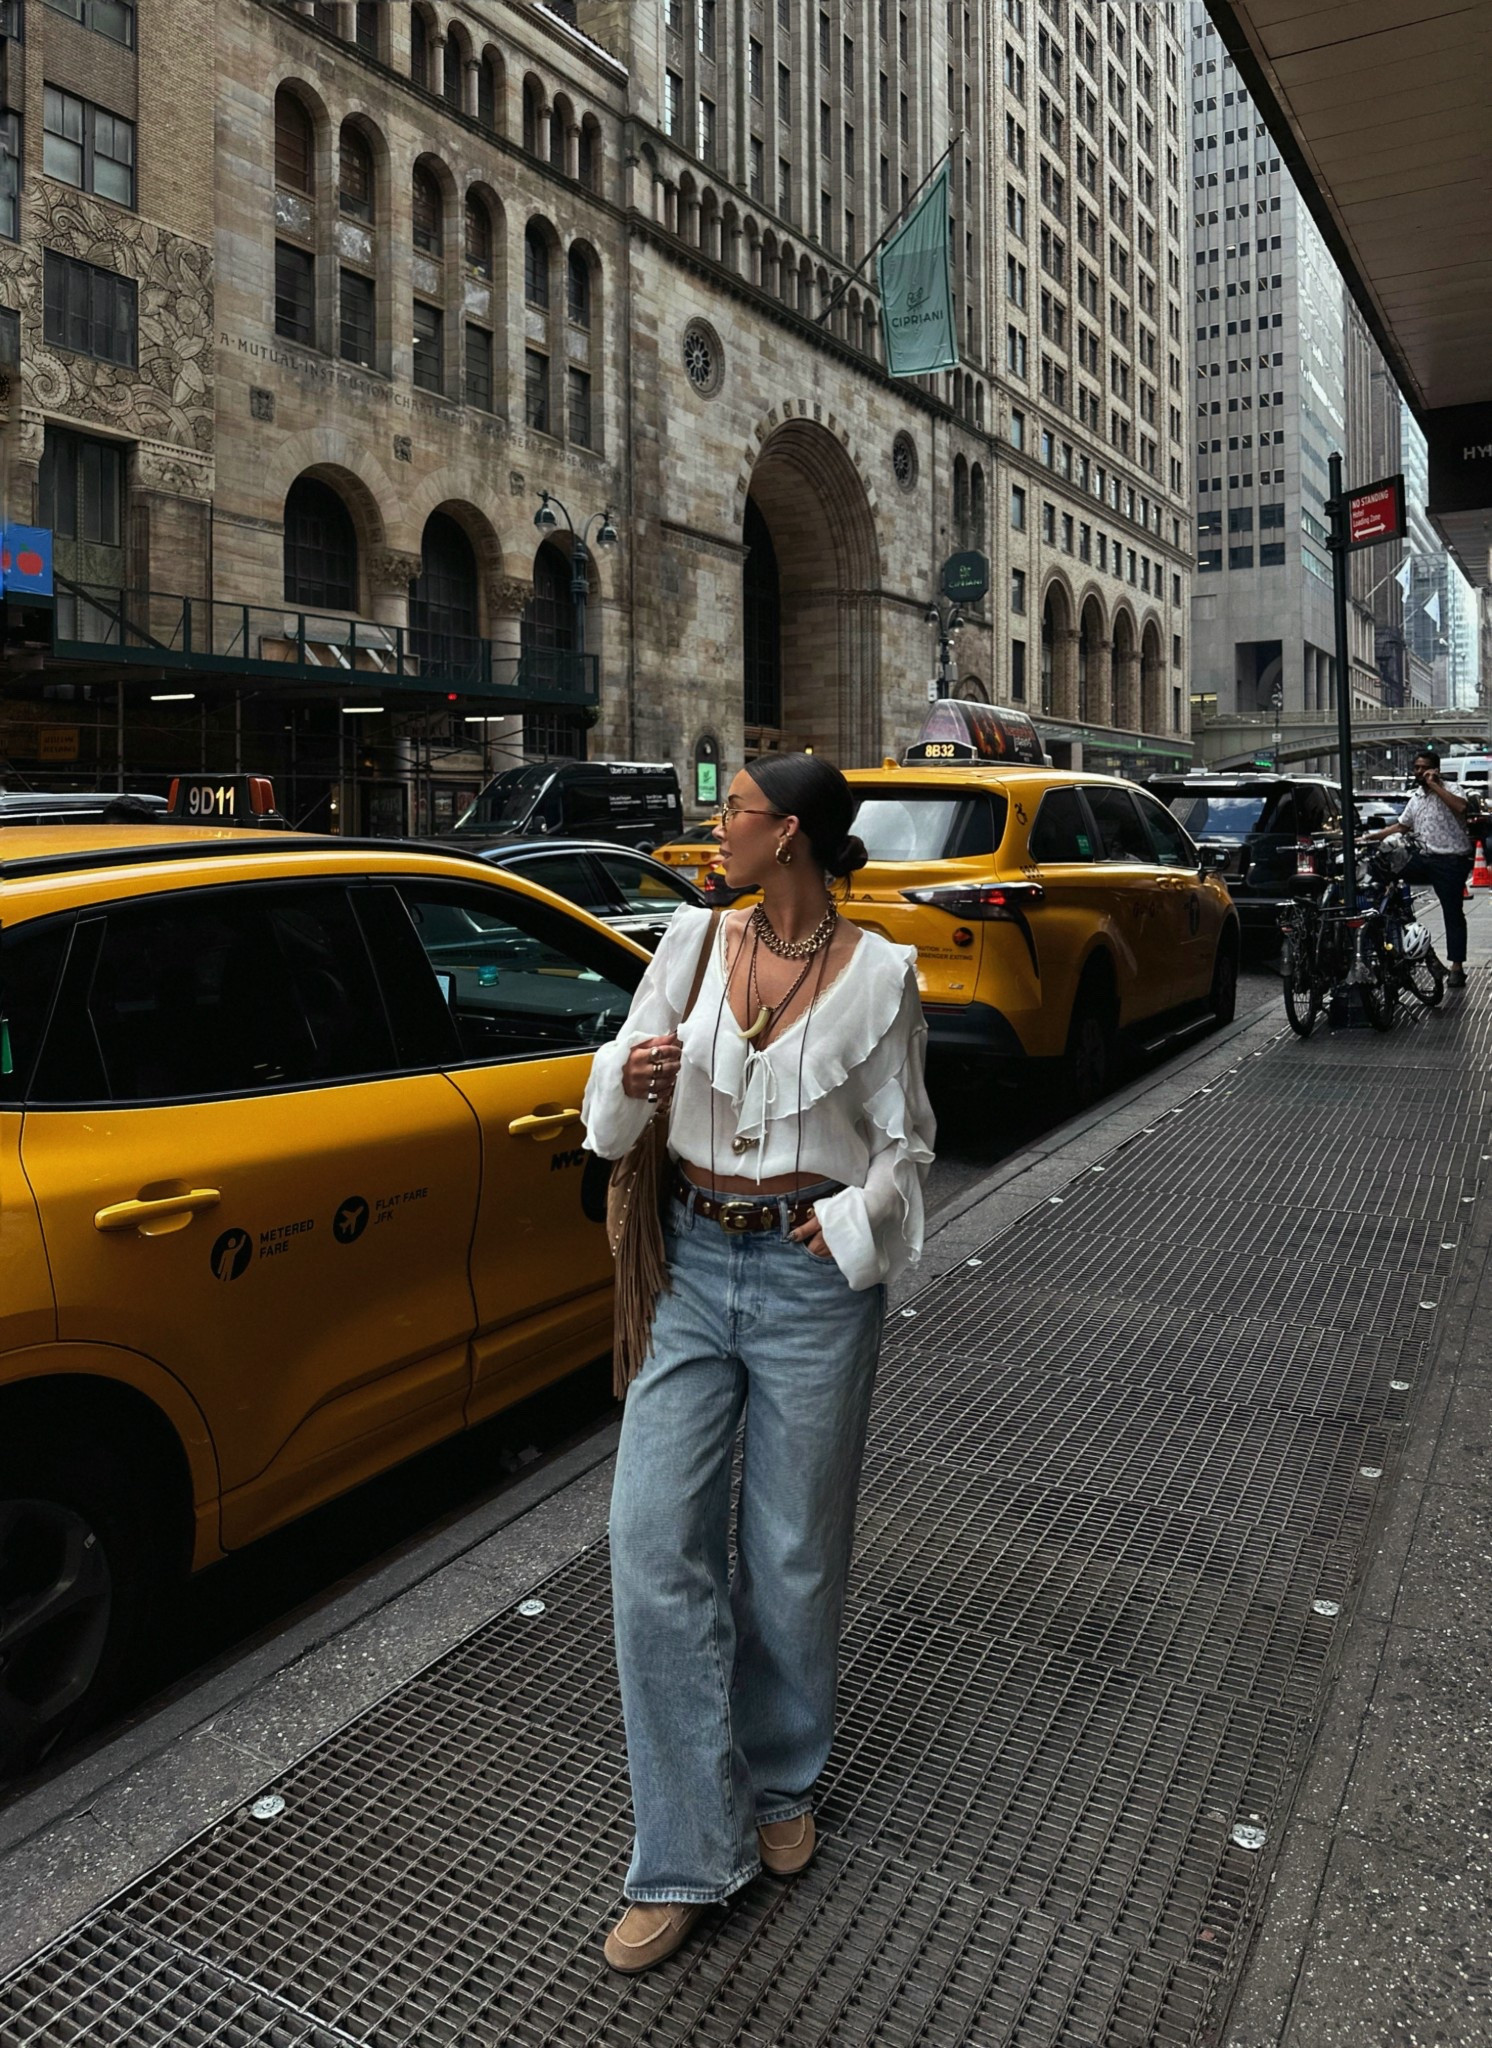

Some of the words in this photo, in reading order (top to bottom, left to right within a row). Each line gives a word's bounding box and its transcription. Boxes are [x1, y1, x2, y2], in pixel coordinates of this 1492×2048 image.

[891, 309, 944, 328] CIPRIANI
[237, 339, 299, 370] MUTUAL
[1352, 498, 1360, 510] NO
[1361, 489, 1389, 507] STANDING
[925, 744, 956, 758] 8B32
[189, 786, 235, 815] 9D11
[917, 952, 948, 960] ASSENGER
[551, 1149, 586, 1171] NYC
[375, 1194, 402, 1211] FLAT
[403, 1187, 429, 1204] FARE
[374, 1210, 394, 1225] JFK
[259, 1219, 315, 1245] METERED
[259, 1240, 290, 1259] FARE
